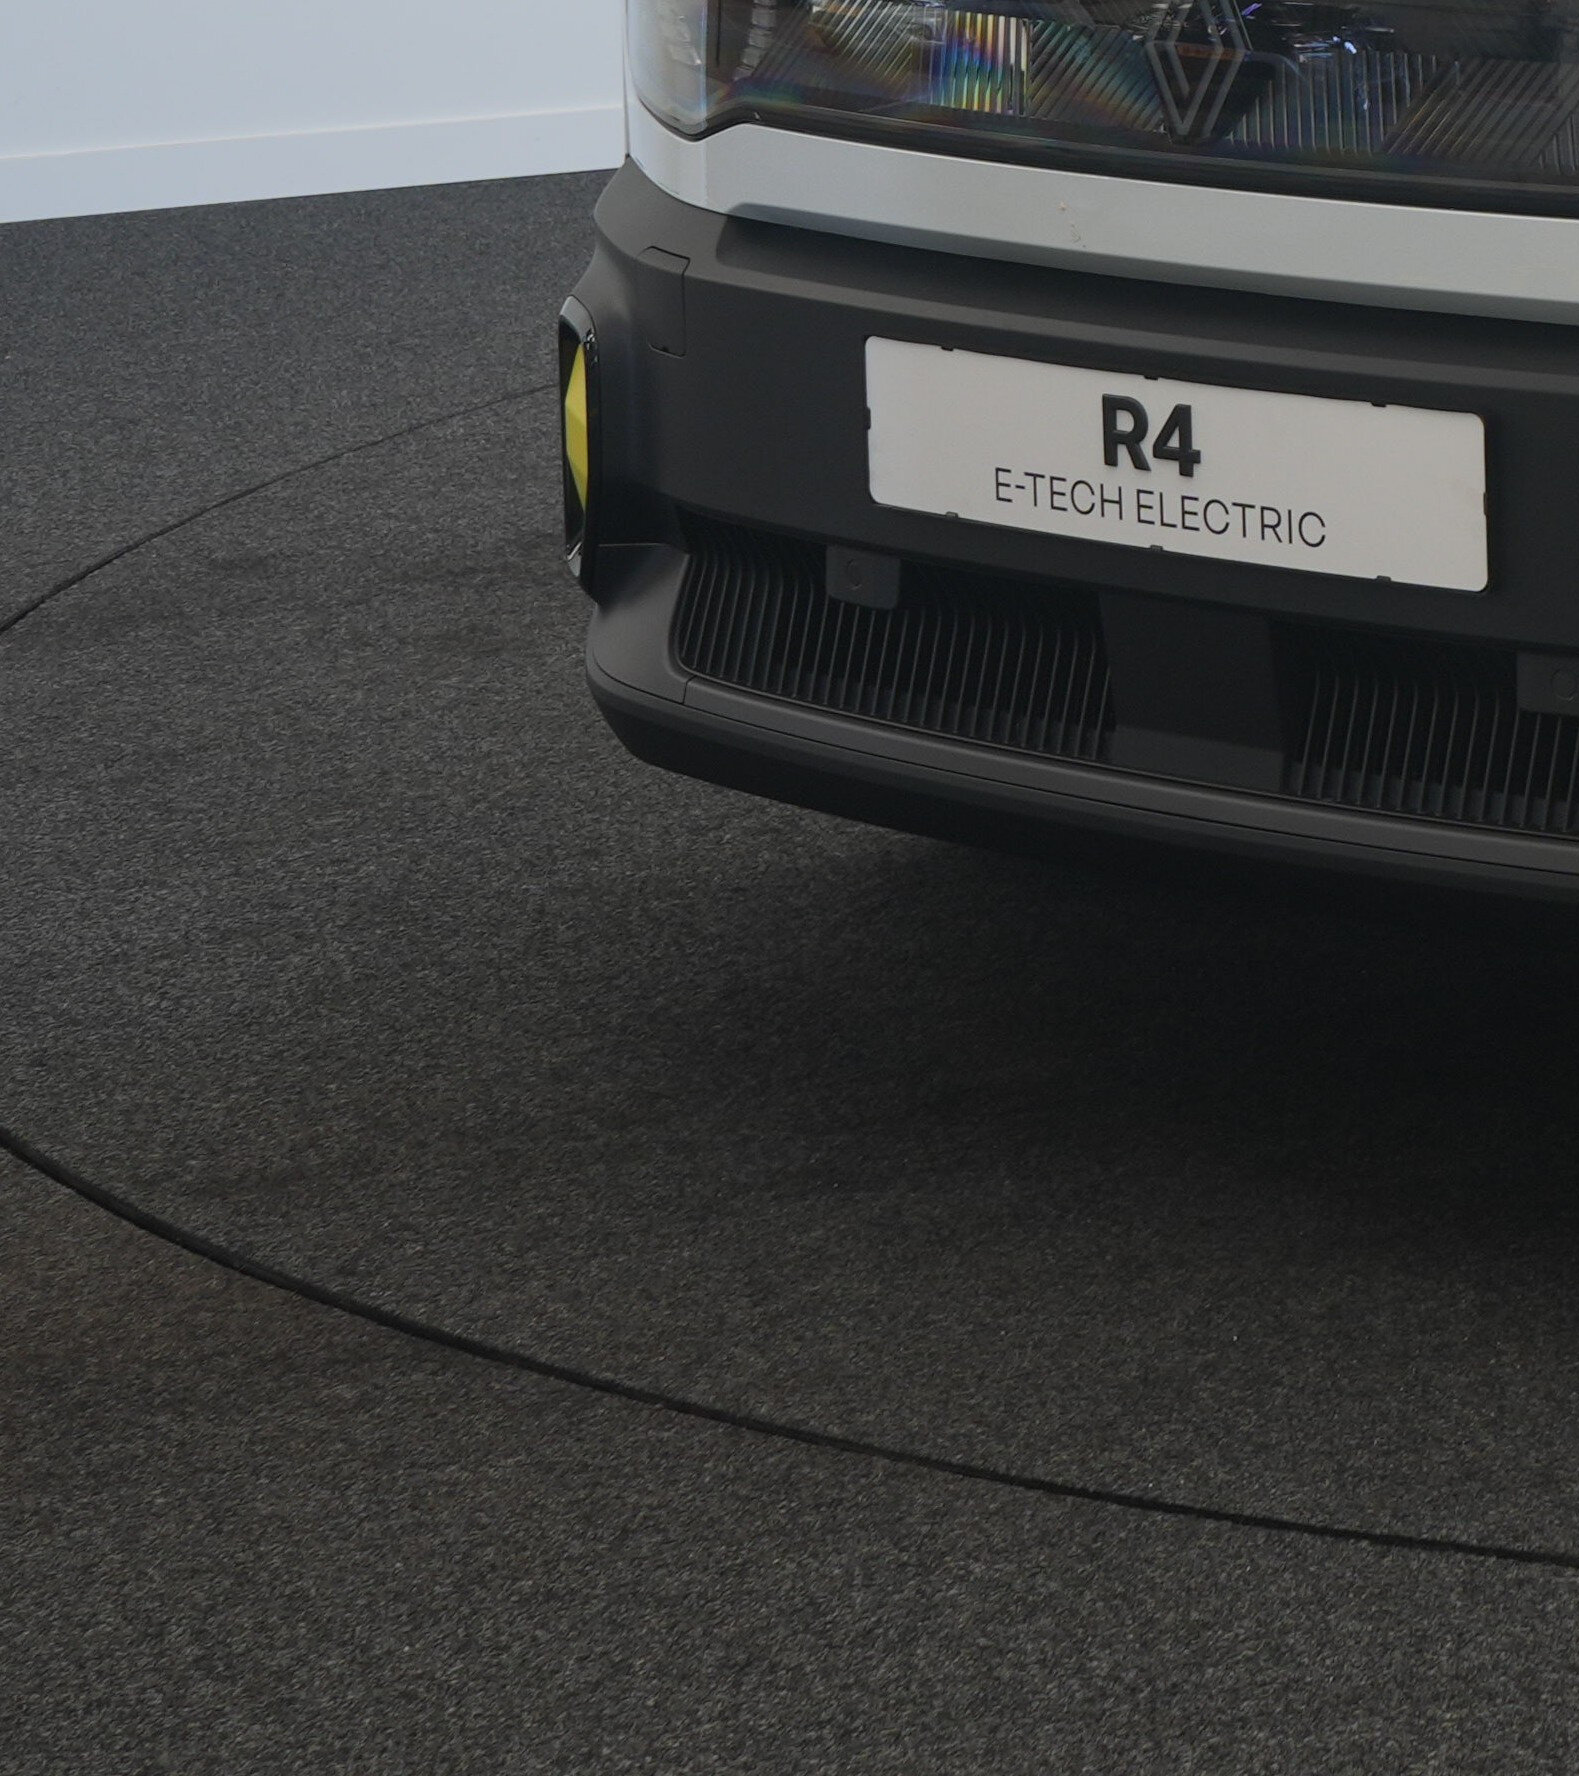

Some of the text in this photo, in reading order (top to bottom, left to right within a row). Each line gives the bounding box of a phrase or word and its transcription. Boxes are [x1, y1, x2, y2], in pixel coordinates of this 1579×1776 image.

[1101, 393, 1202, 478] R4
[994, 467, 1327, 548] E-TECH ELECTRIC
